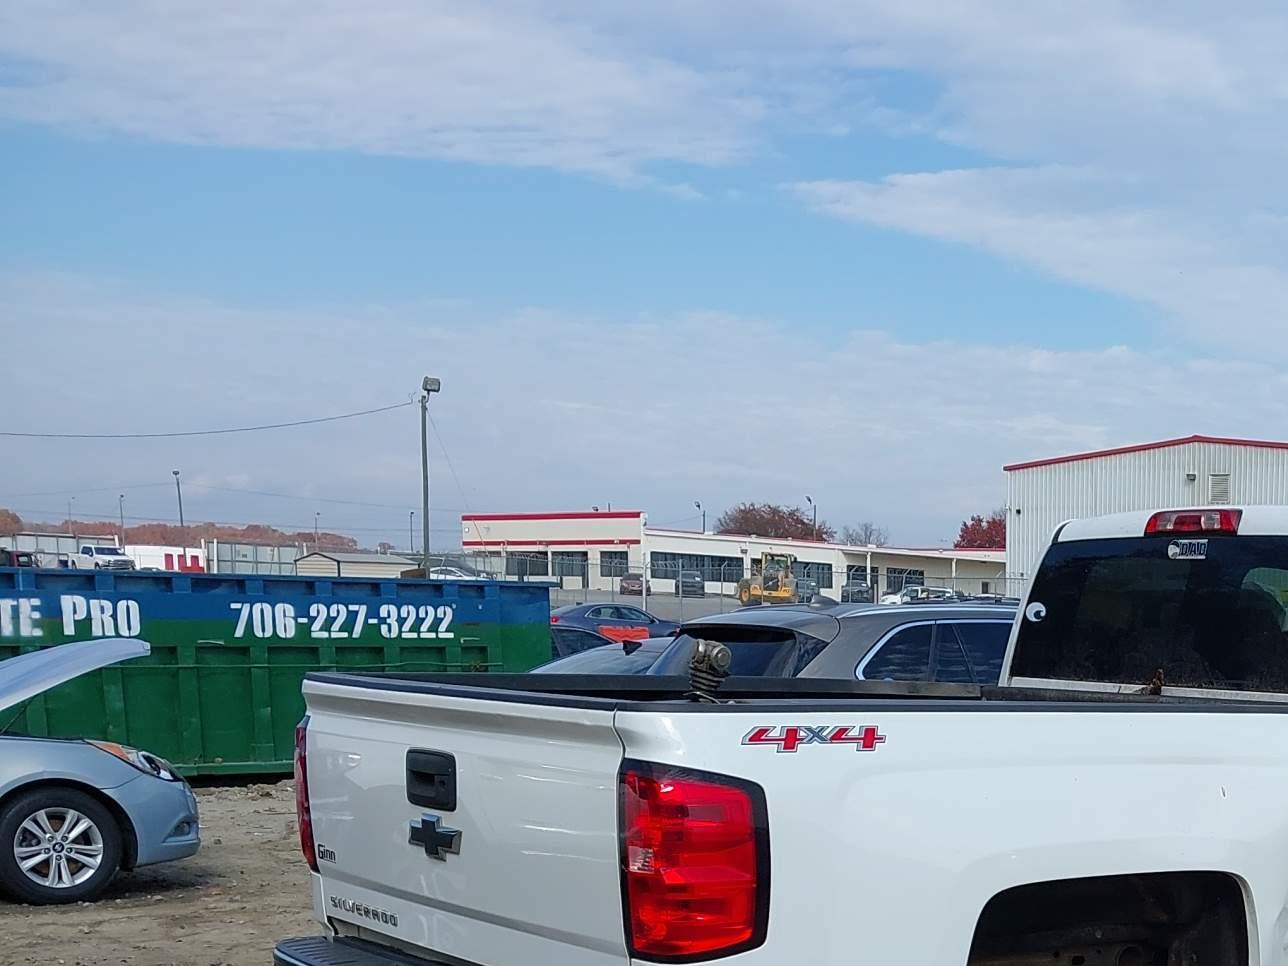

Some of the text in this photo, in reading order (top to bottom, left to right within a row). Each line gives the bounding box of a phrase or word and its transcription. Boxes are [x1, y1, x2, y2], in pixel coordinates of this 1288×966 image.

[60, 594, 141, 637] PRO
[230, 602, 455, 639] 706-227-3222
[317, 843, 337, 862] Ginn
[330, 895, 399, 927] SILVERADO
